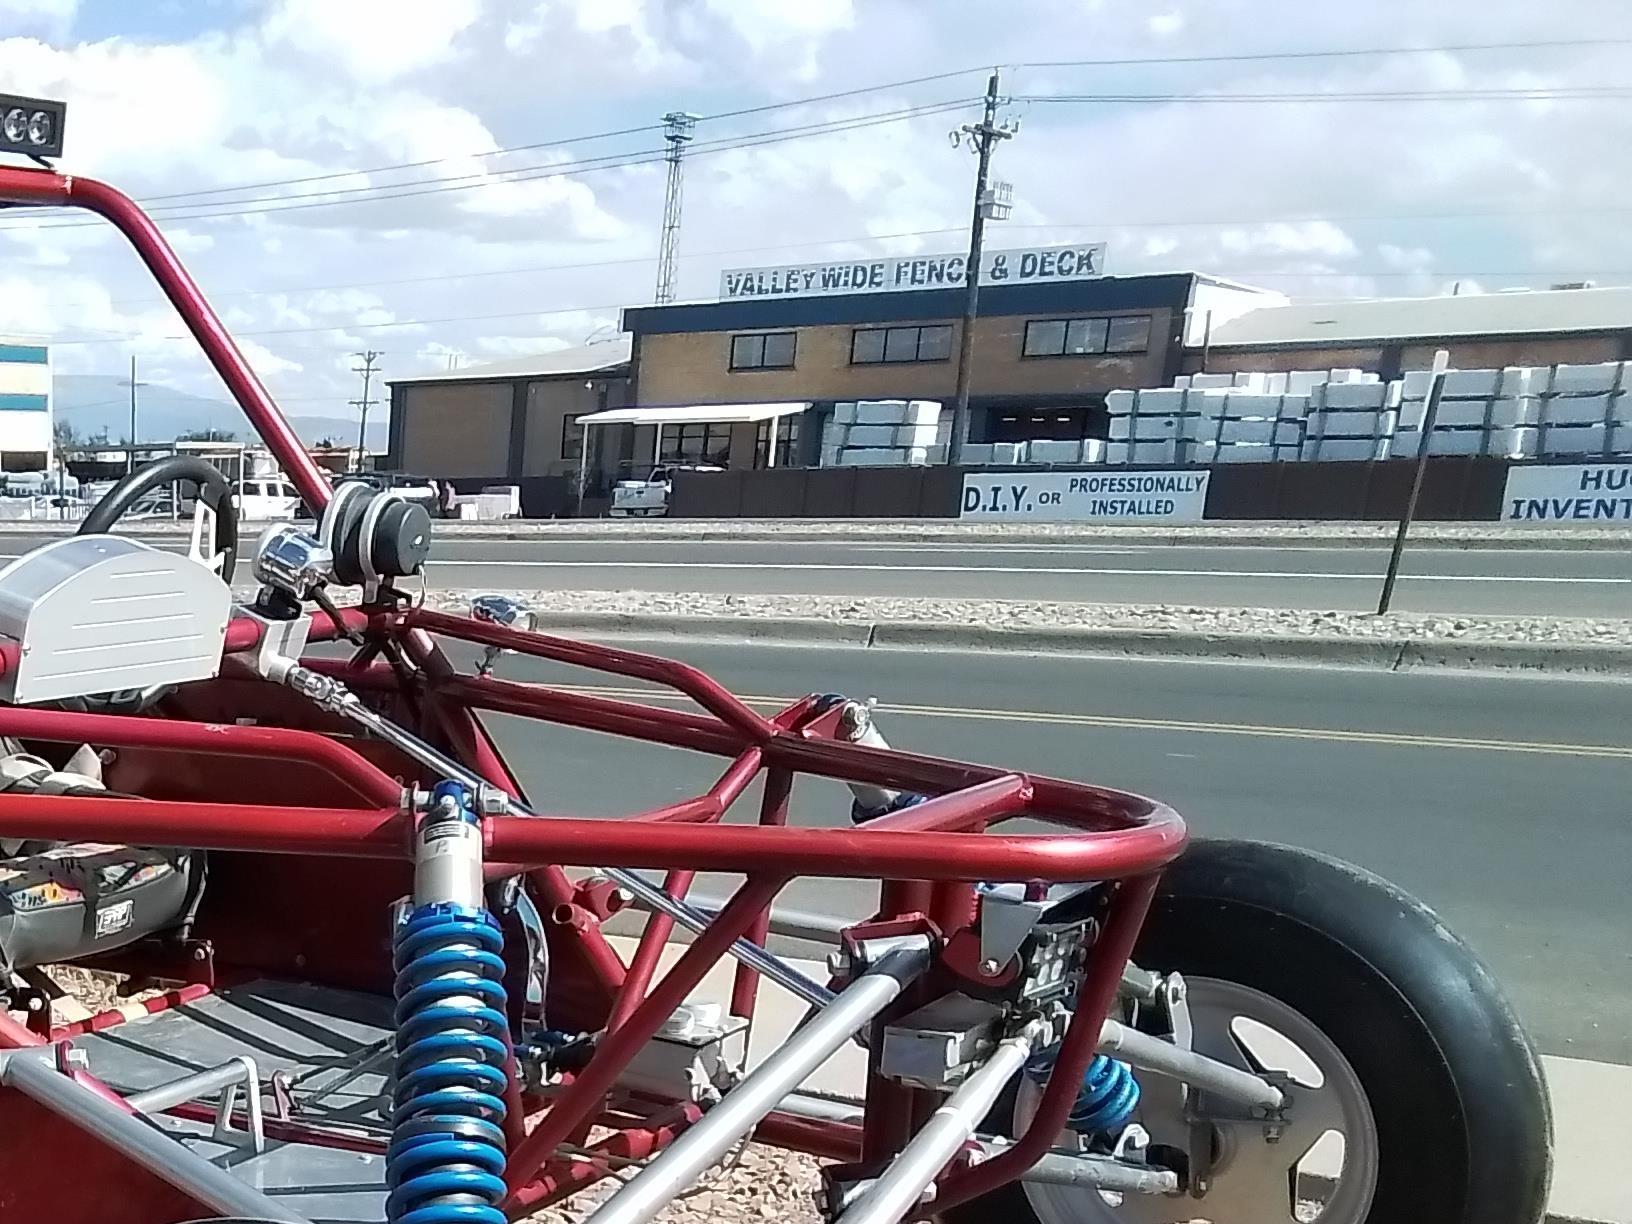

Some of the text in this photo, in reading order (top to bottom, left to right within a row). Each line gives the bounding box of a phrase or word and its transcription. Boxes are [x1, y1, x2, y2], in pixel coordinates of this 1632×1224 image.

[727, 248, 1099, 297] VALLEY WIDE FENC & DECK
[1069, 476, 1206, 493] PROFESSIONALLY
[1579, 469, 1632, 491] HU
[963, 486, 1062, 512] D.I.Y. OR
[1090, 499, 1174, 516] INSTALLED
